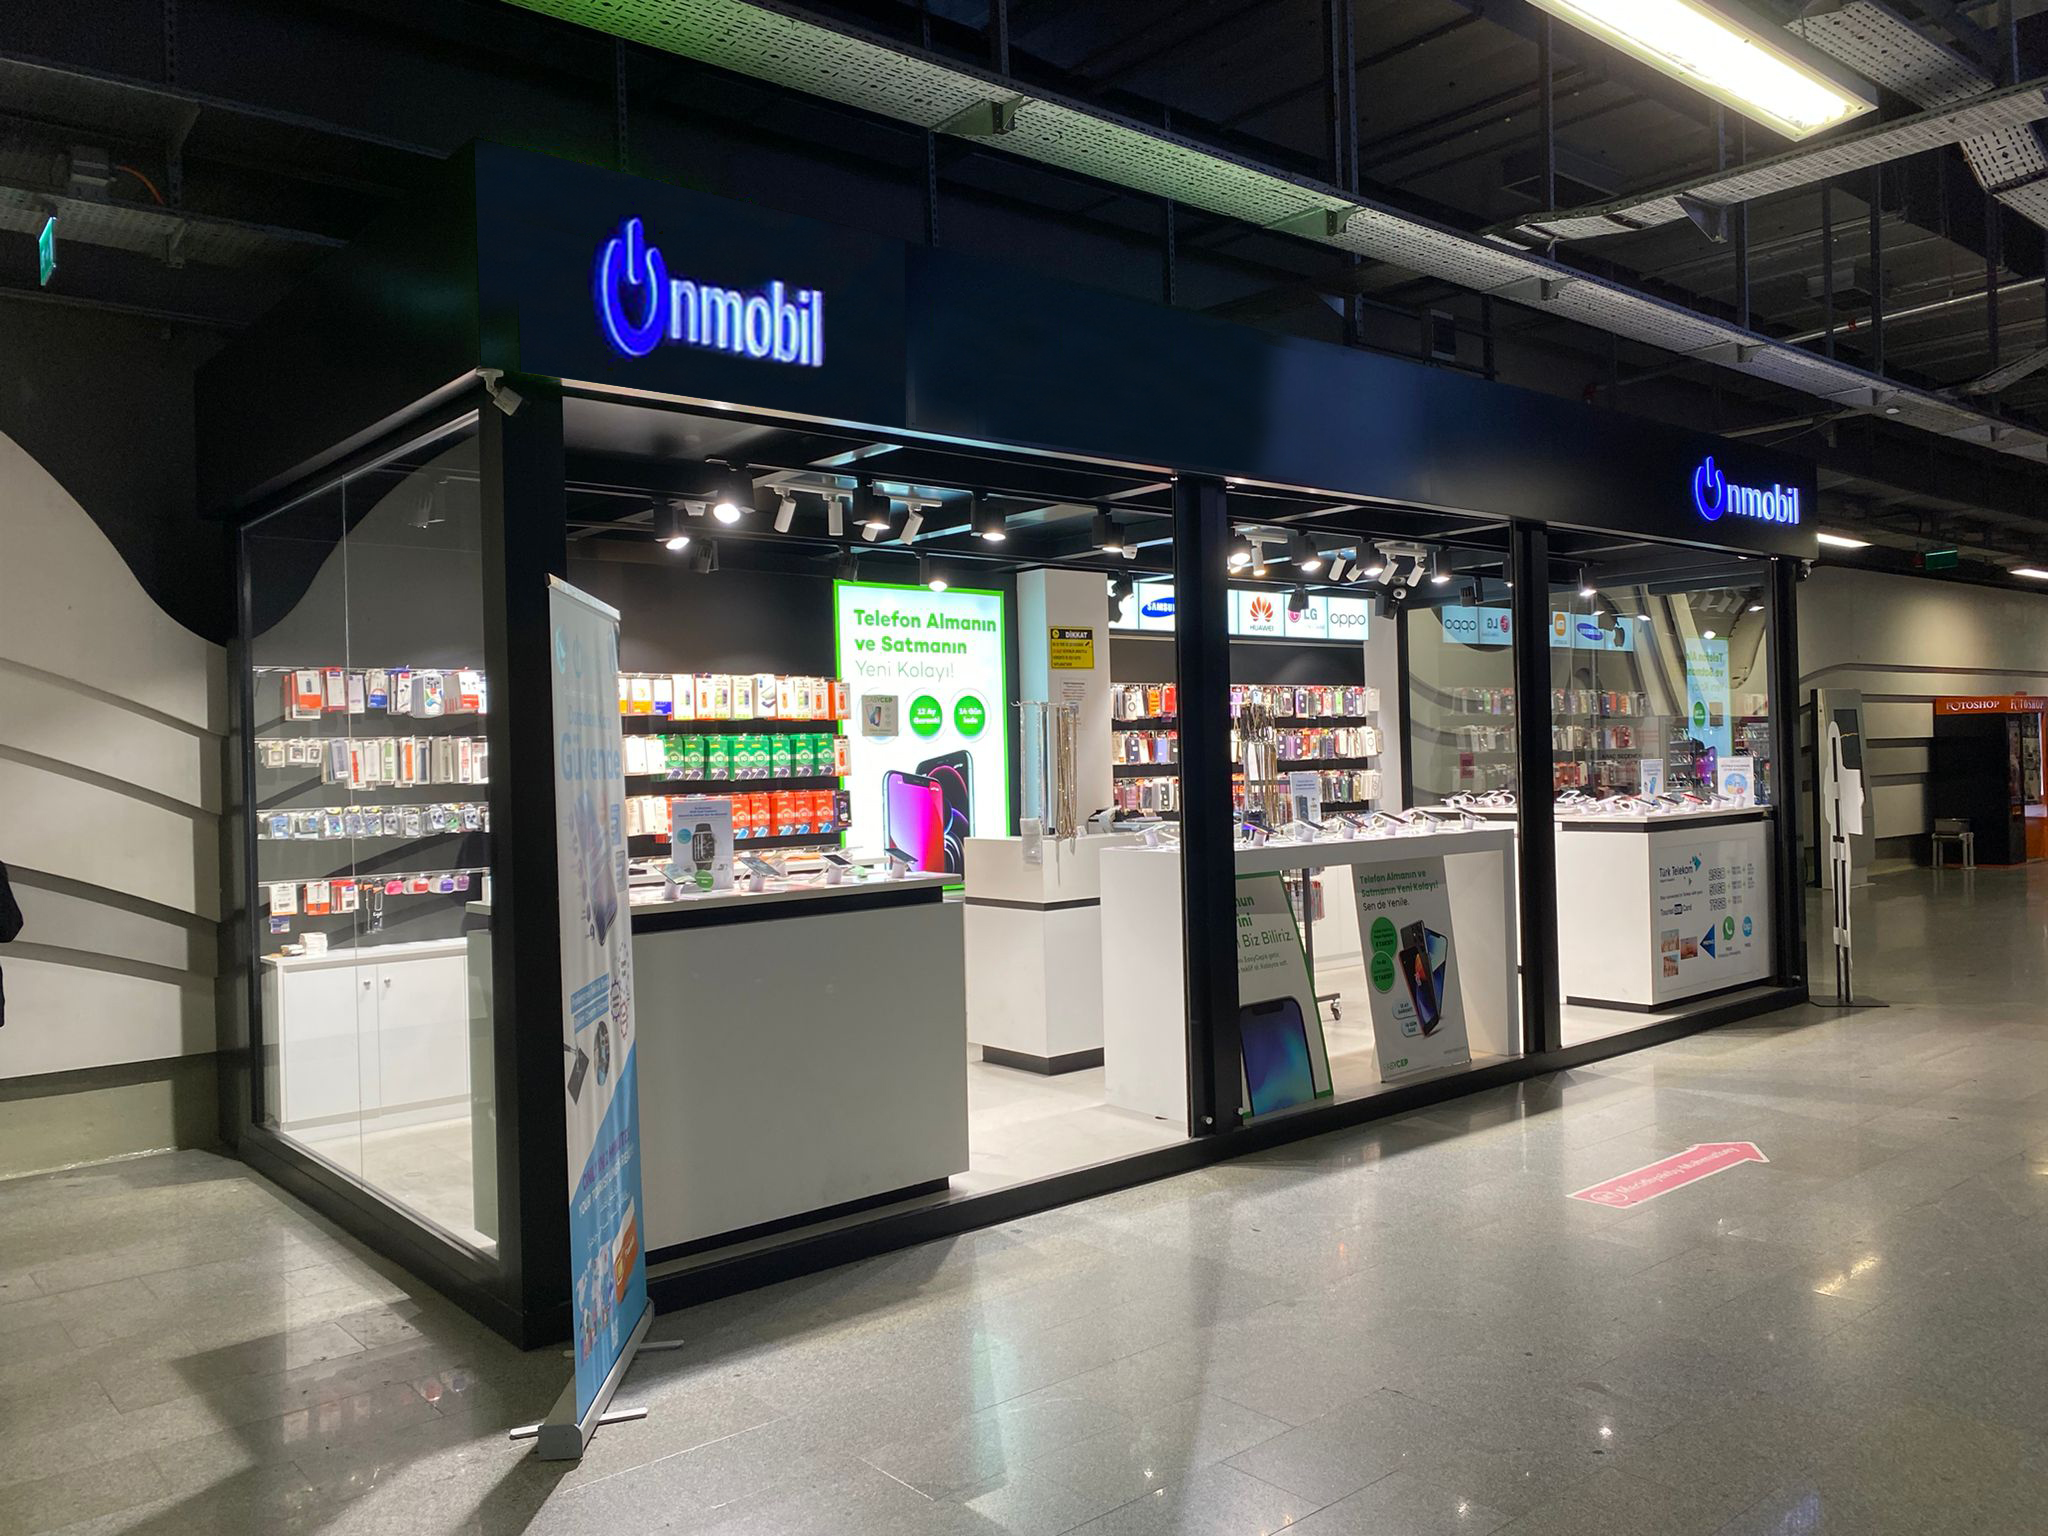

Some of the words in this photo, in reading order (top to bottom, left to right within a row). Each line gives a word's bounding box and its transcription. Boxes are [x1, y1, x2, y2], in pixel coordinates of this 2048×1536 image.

[1147, 601, 1175, 613] SAMSU
[1303, 608, 1318, 620] LG
[854, 608, 921, 629] Telefon
[926, 612, 997, 632] Almanın
[1065, 630, 1088, 639] DİKKAT
[854, 639, 876, 651] ve
[881, 635, 967, 654] Satmanın
[855, 659, 891, 677] Yeni
[897, 660, 954, 683] Kolayı!
[1946, 701, 2000, 711] FOTOSHOP
[1359, 874, 1386, 884] Telefon
[1386, 871, 1417, 881] Almanın
[1417, 870, 1426, 878] ve
[1361, 886, 1397, 898] Satmanın
[1397, 882, 1413, 893] Yeni
[1362, 902, 1377, 911] Sen
[1376, 901, 1386, 910] de
[1242, 933, 1260, 948] Biz
[1261, 929, 1294, 945] Biliriz.
